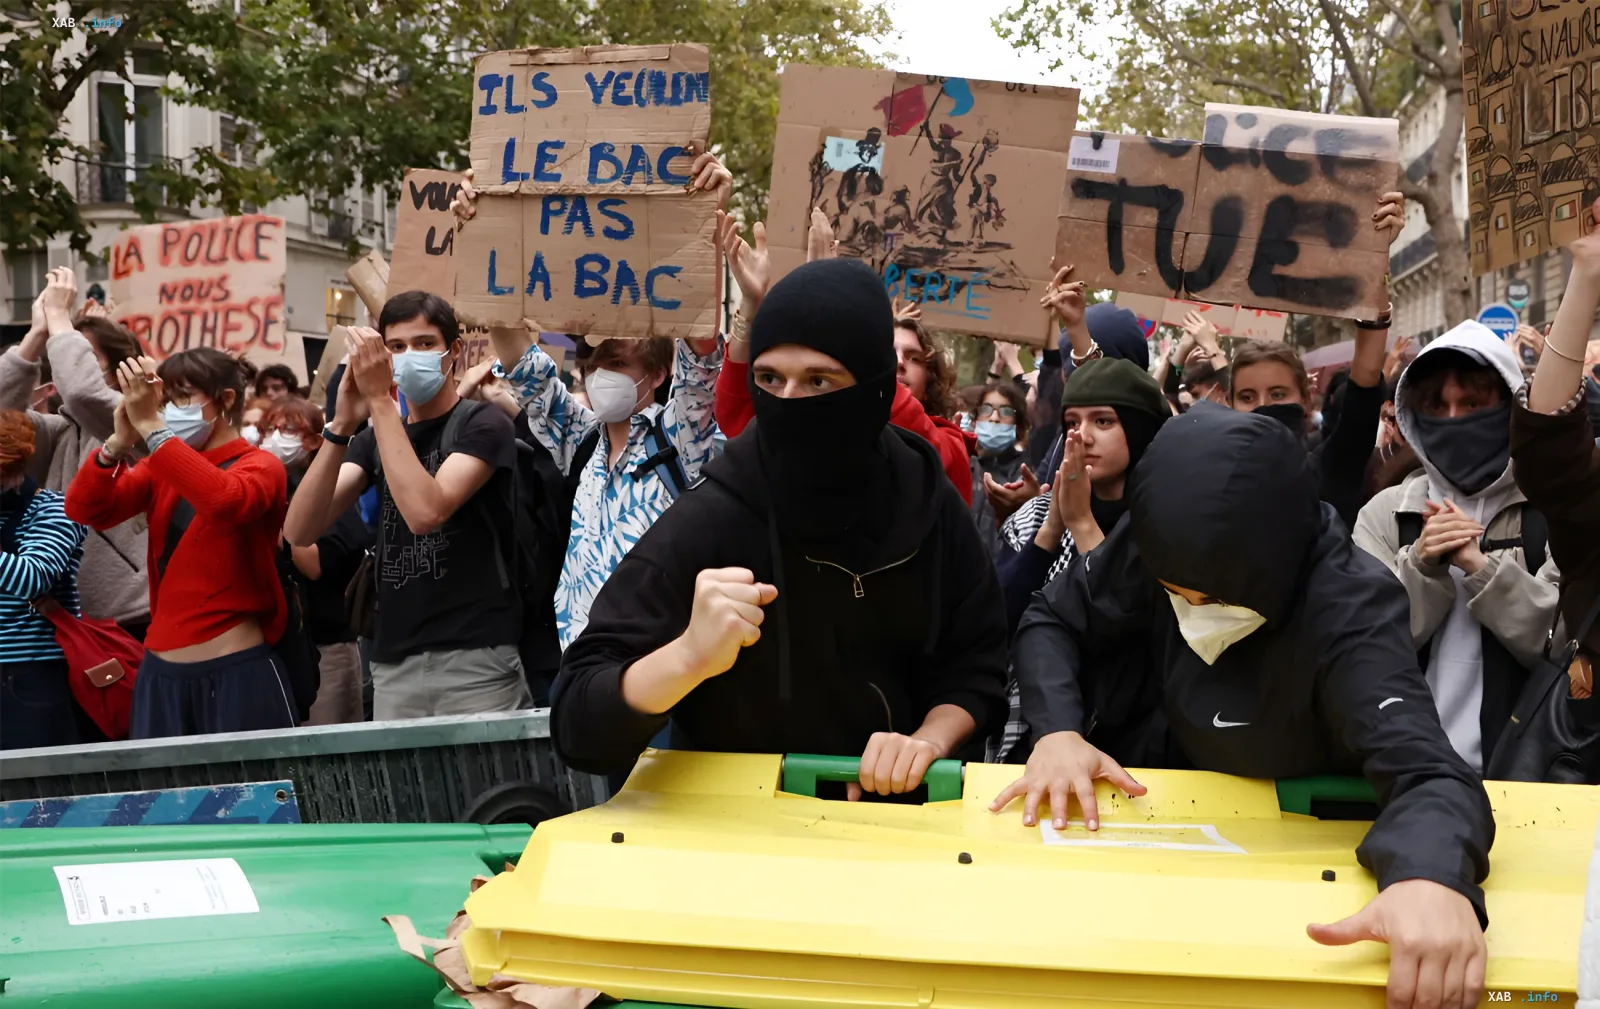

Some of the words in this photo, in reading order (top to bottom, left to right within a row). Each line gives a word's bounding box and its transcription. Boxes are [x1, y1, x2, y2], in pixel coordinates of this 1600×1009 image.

[478, 71, 558, 115] ILS
[501, 137, 565, 185] LE
[587, 140, 693, 187] BAC
[539, 194, 636, 240] PAS
[113, 235, 145, 280] LA
[158, 214, 283, 268] POLICE
[1071, 178, 1364, 308] TUE
[158, 273, 231, 305] NOUS
[487, 247, 553, 302] LA
[574, 252, 684, 311] BAC
